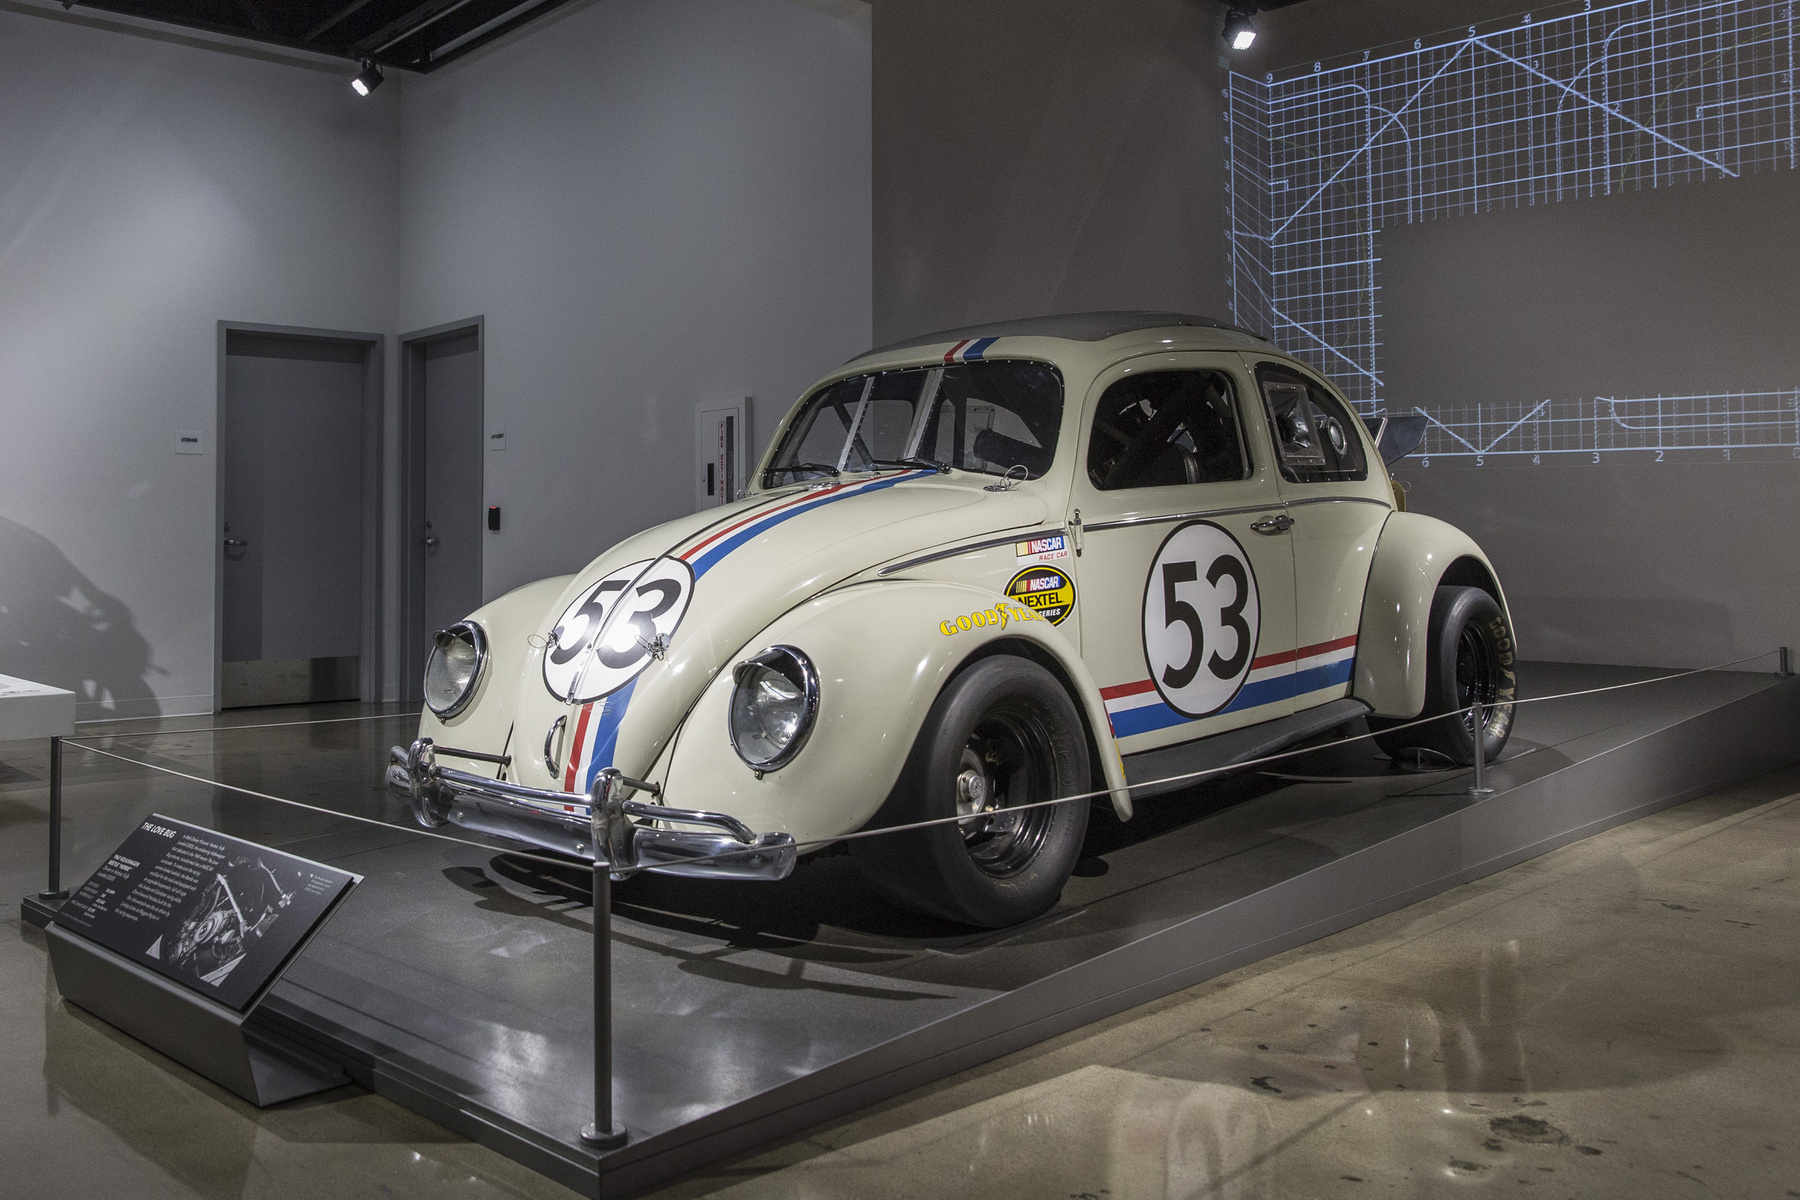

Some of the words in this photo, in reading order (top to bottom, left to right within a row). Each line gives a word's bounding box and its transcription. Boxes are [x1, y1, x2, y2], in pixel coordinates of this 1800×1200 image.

[1583, 0, 1591, 11] 3
[1468, 25, 1476, 38] 5
[1413, 38, 1422, 50] 6
[1313, 61, 1322, 72] 8
[1266, 73, 1273, 84] 9
[1421, 456, 1430, 468] 6
[1476, 455, 1484, 467] 5
[1592, 452, 1600, 464] 3
[1655, 450, 1664, 462] 2
[1031, 536, 1063, 554] NASCAR
[1039, 553, 1054, 561] RACE
[1056, 551, 1068, 559] CAR
[1030, 576, 1060, 591] NASCAR
[1018, 592, 1063, 608] NEXTEL
[550, 579, 682, 669] 53
[1162, 554, 1250, 689] 53
[1489, 616, 1516, 738] GOODYEAR
[142, 822, 152, 832] THE
[150, 825, 166, 835] LOVE
[163, 828, 177, 839] BUG
